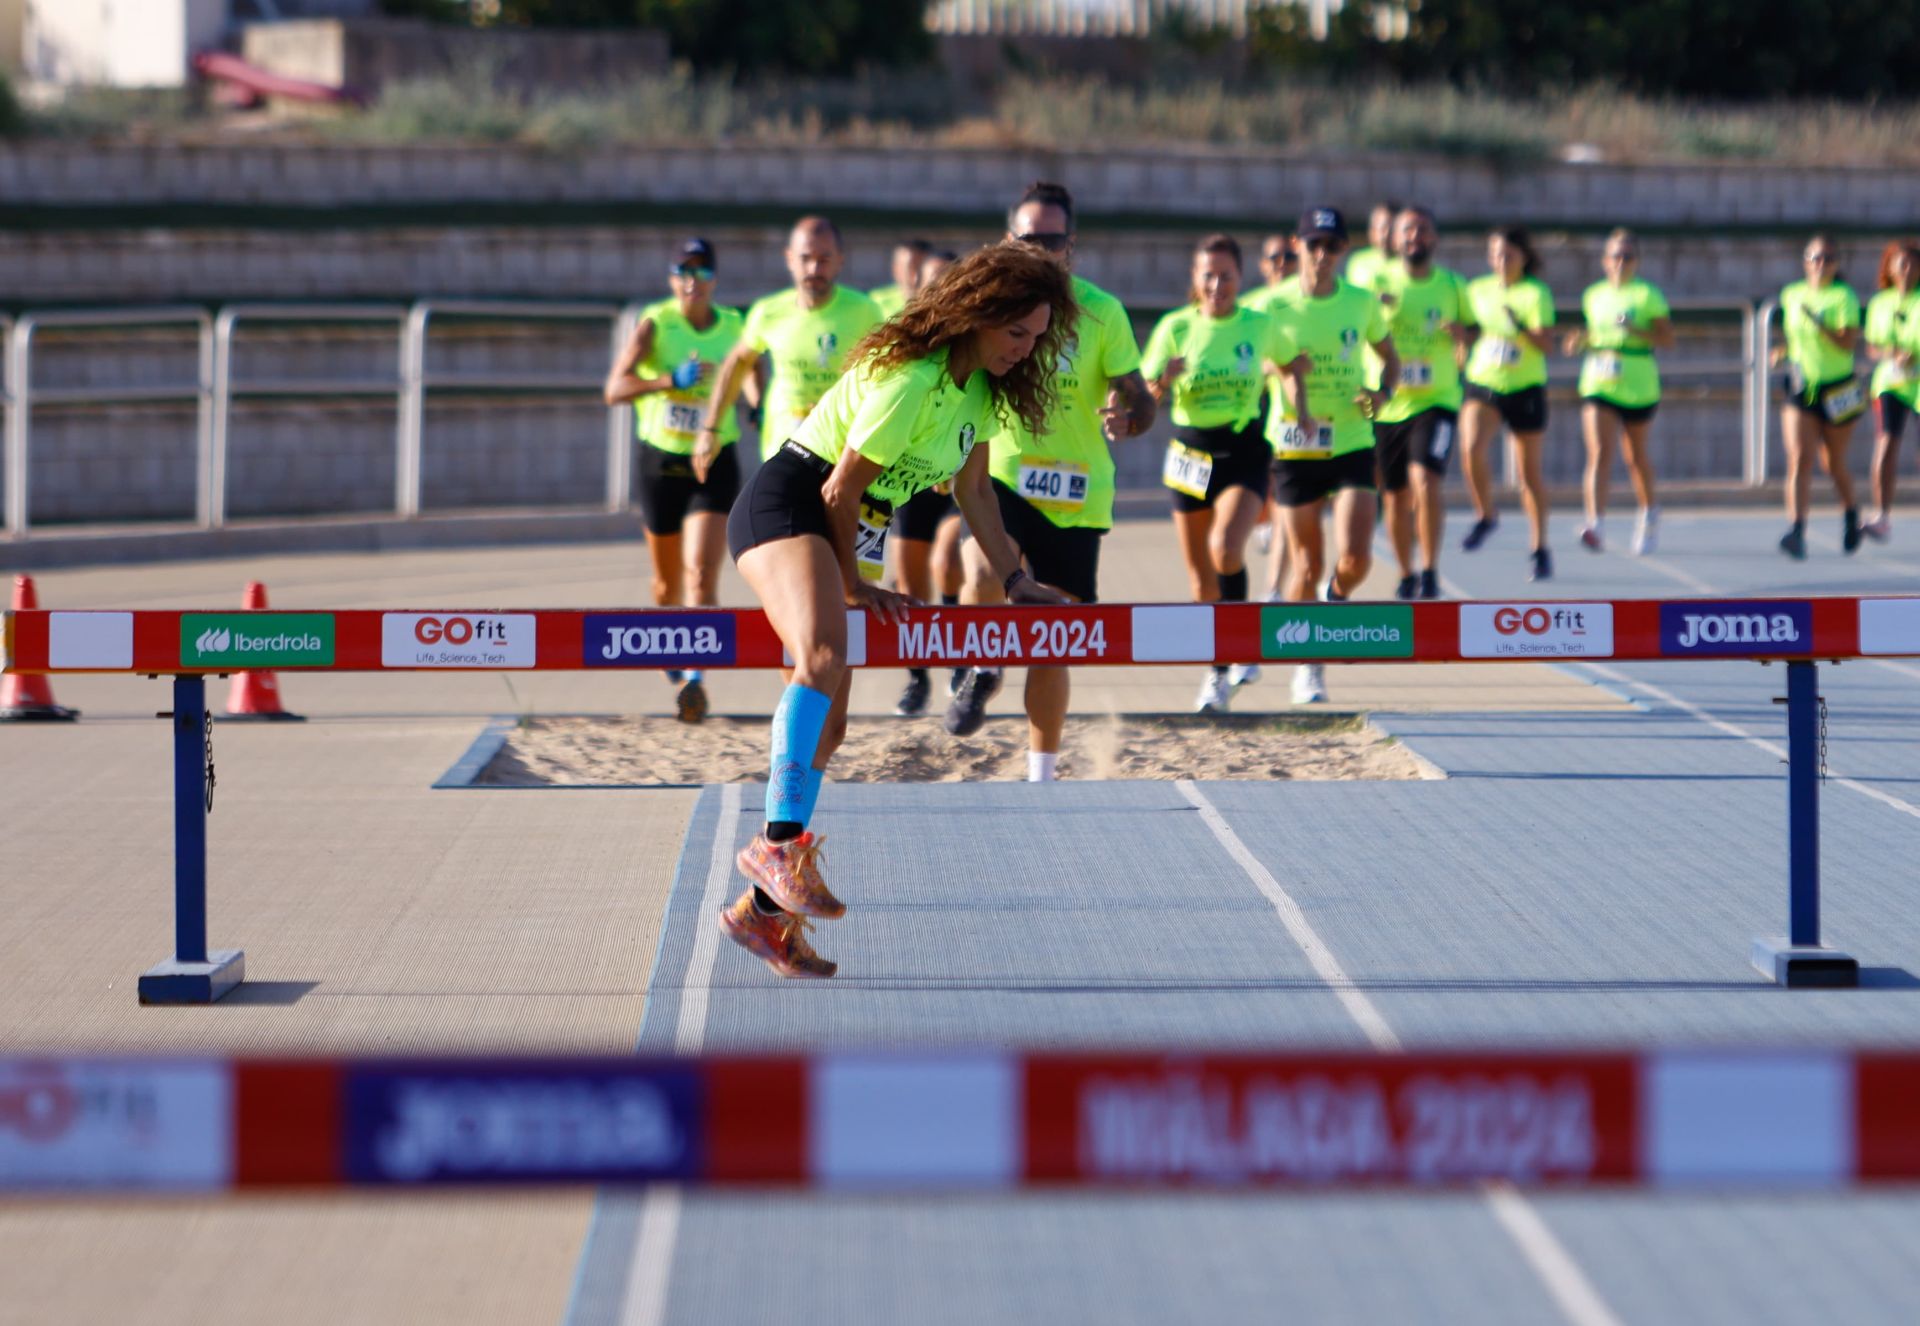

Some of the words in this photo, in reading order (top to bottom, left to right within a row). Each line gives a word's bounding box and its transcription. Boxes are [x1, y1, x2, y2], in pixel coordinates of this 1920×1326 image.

[1026, 470, 1061, 497] 440
[235, 633, 322, 651] Iberdrola
[899, 612, 1022, 659] MÁLAGA
[1030, 619, 1107, 658] 2024
[1315, 624, 1400, 642] Iberdrola
